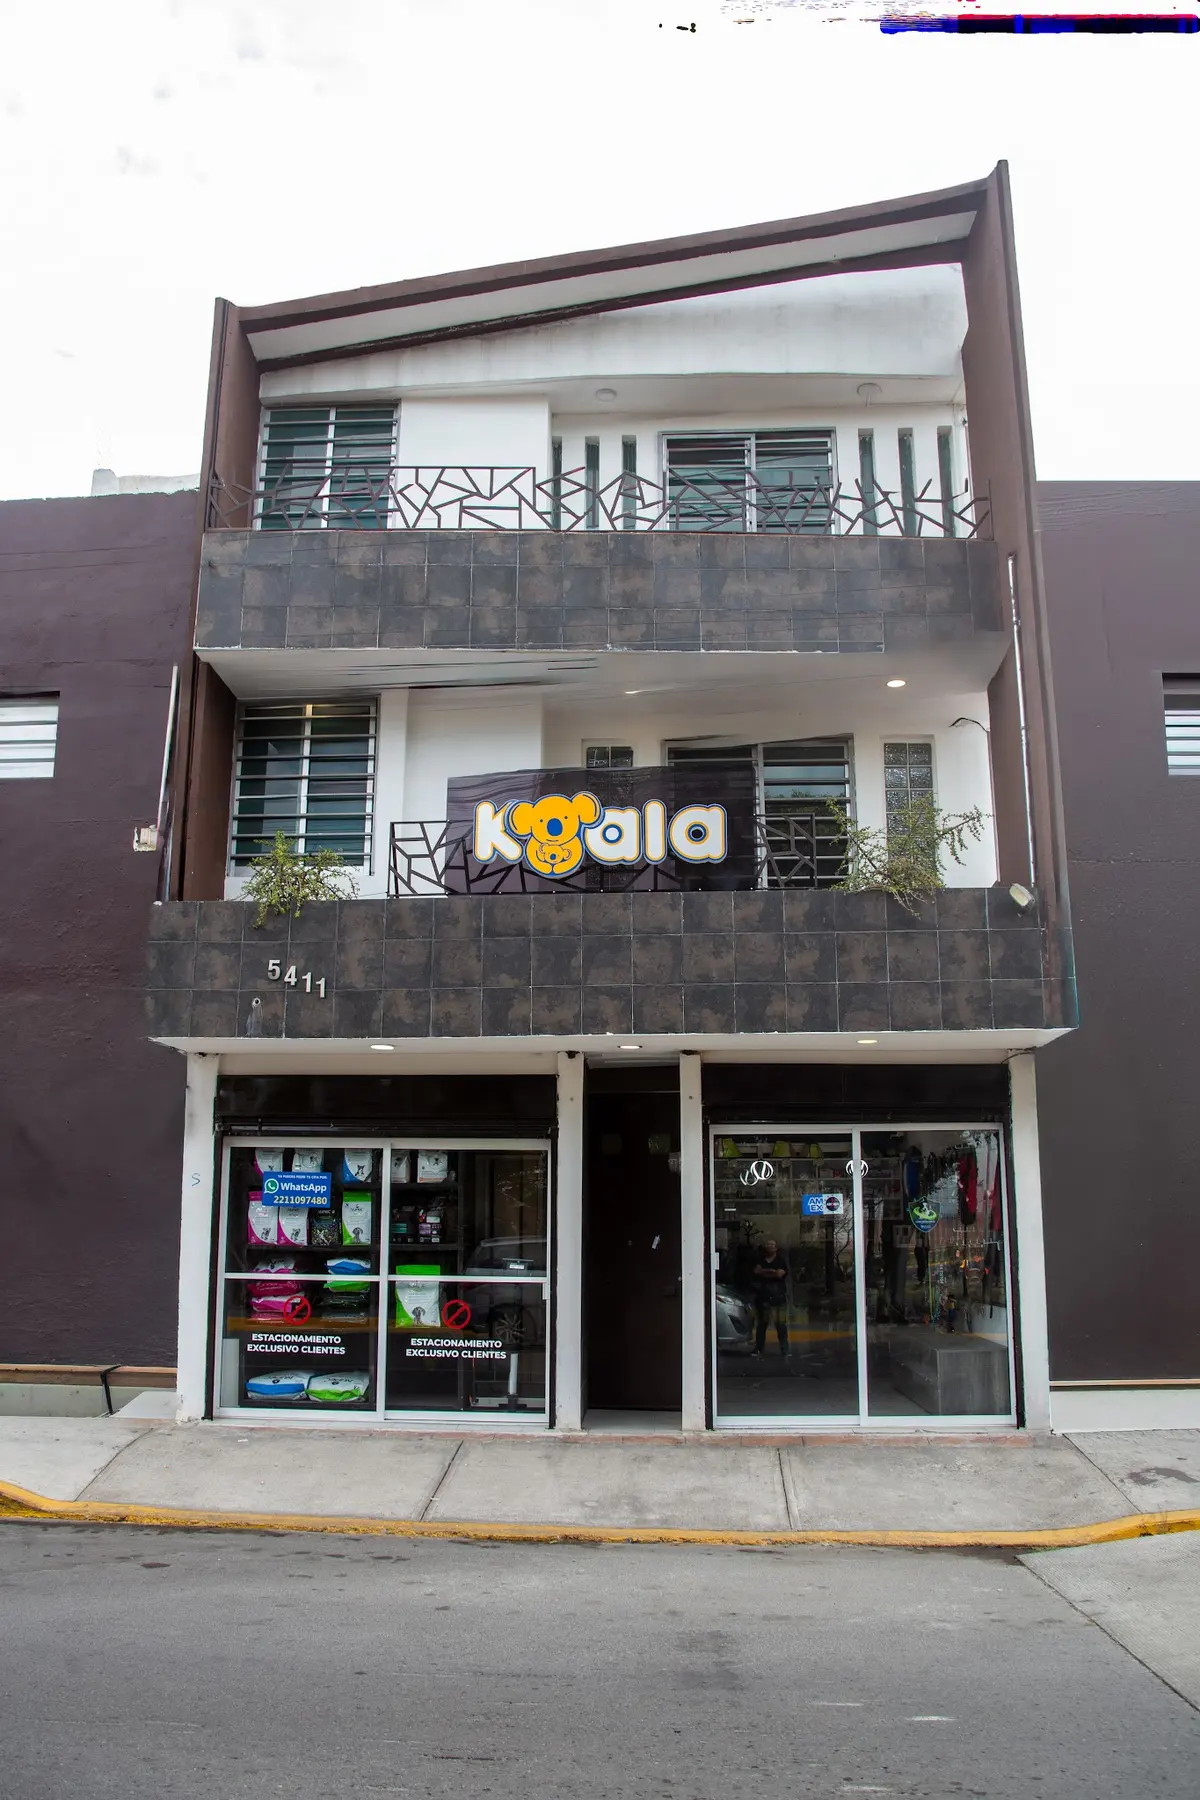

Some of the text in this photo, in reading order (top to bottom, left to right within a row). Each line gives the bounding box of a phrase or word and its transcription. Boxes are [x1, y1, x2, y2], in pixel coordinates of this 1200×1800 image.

[267, 959, 326, 999] 5411
[280, 1182, 327, 1194] WhatsApp
[273, 1195, 328, 1205] 2211097480
[251, 1333, 342, 1344] ESTACIONAMIENTO
[410, 1338, 503, 1348] ESTACIONAMIENTO
[247, 1343, 346, 1355] EXCLUSIVO CLIENTES
[405, 1348, 507, 1359] EXCLUSIVO CLIENTES
